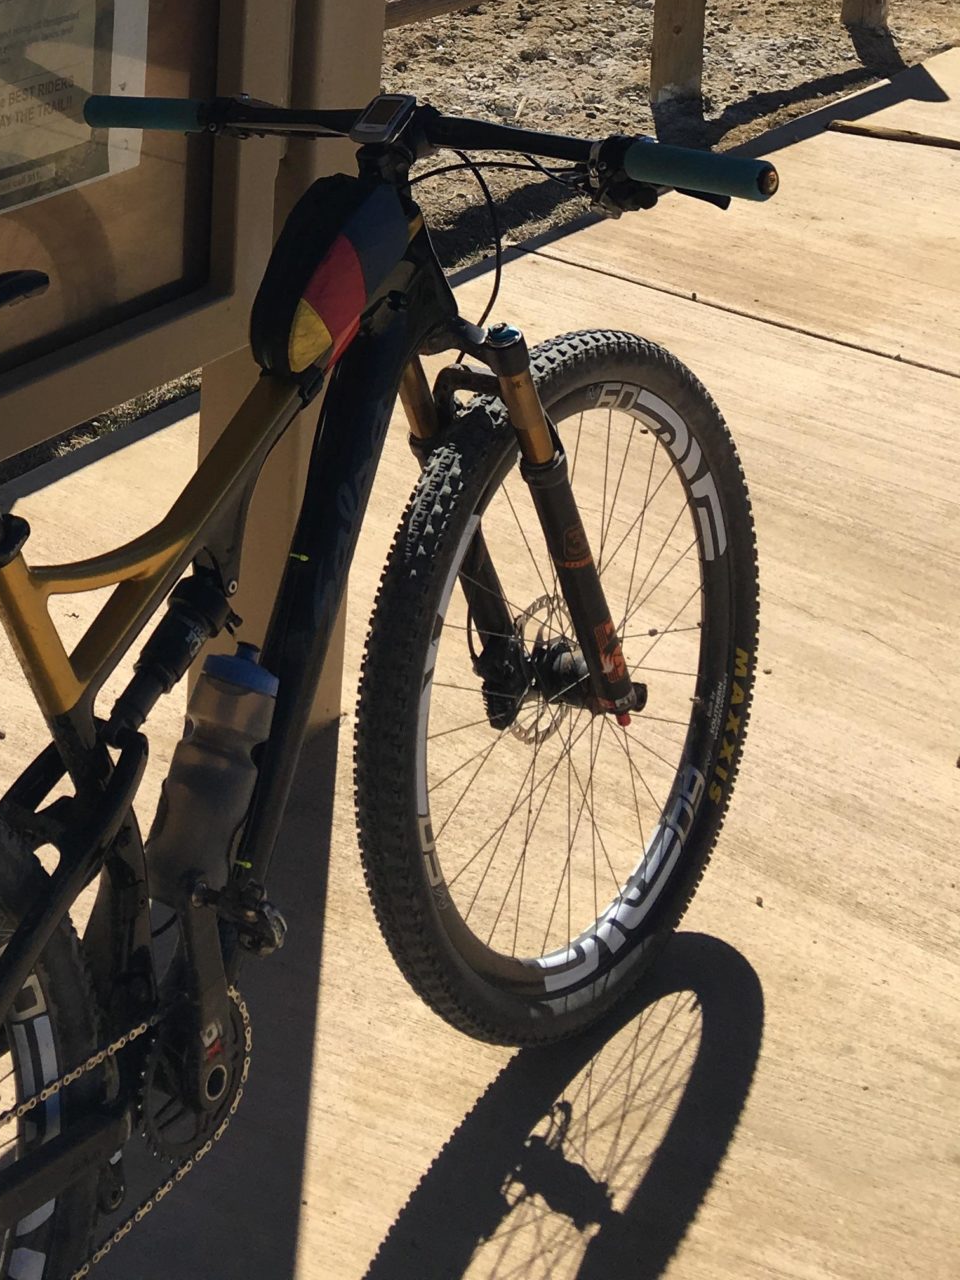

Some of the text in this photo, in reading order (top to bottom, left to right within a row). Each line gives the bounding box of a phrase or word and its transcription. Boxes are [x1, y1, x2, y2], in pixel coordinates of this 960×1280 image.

[8, 84, 35, 106] BEST
[15, 106, 34, 125] THE
[708, 647, 749, 805] MAXXIS
